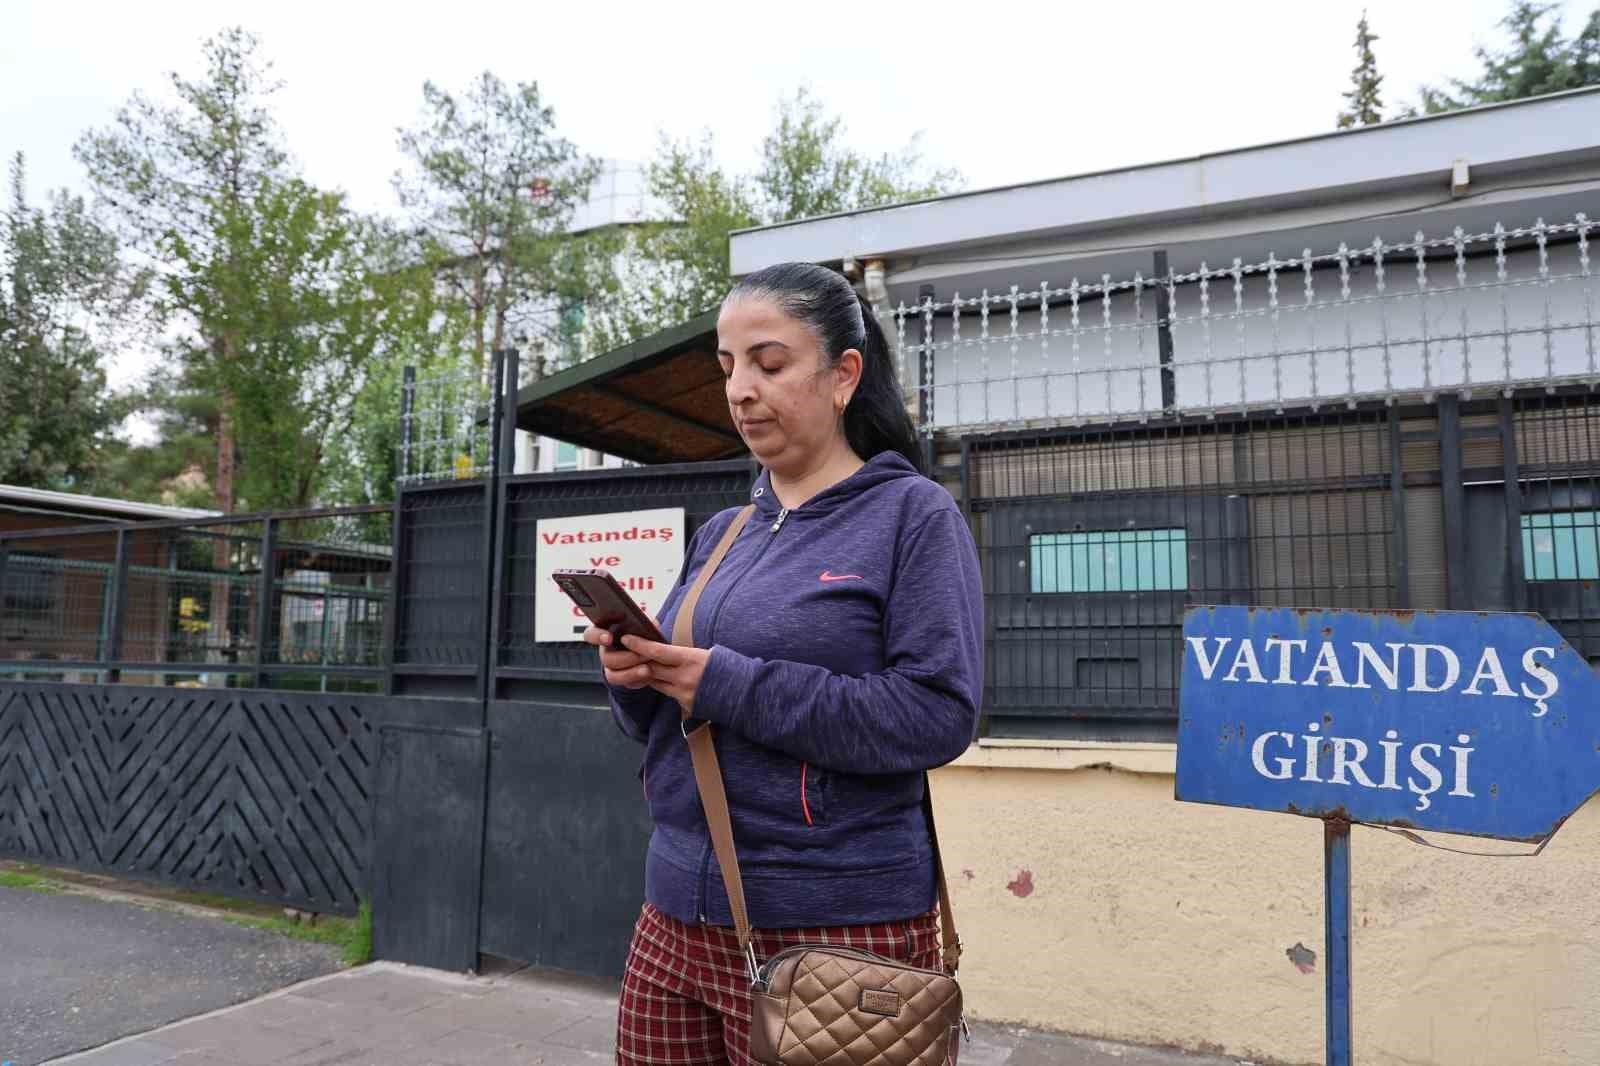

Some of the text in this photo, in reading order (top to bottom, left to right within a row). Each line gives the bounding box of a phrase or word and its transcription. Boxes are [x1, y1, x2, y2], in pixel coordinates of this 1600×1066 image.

[542, 526, 673, 545] Vatandaş
[590, 555, 621, 567] ve
[1187, 637, 1559, 717] VATANDAŞ
[1251, 723, 1475, 811] GİRİŞİ
